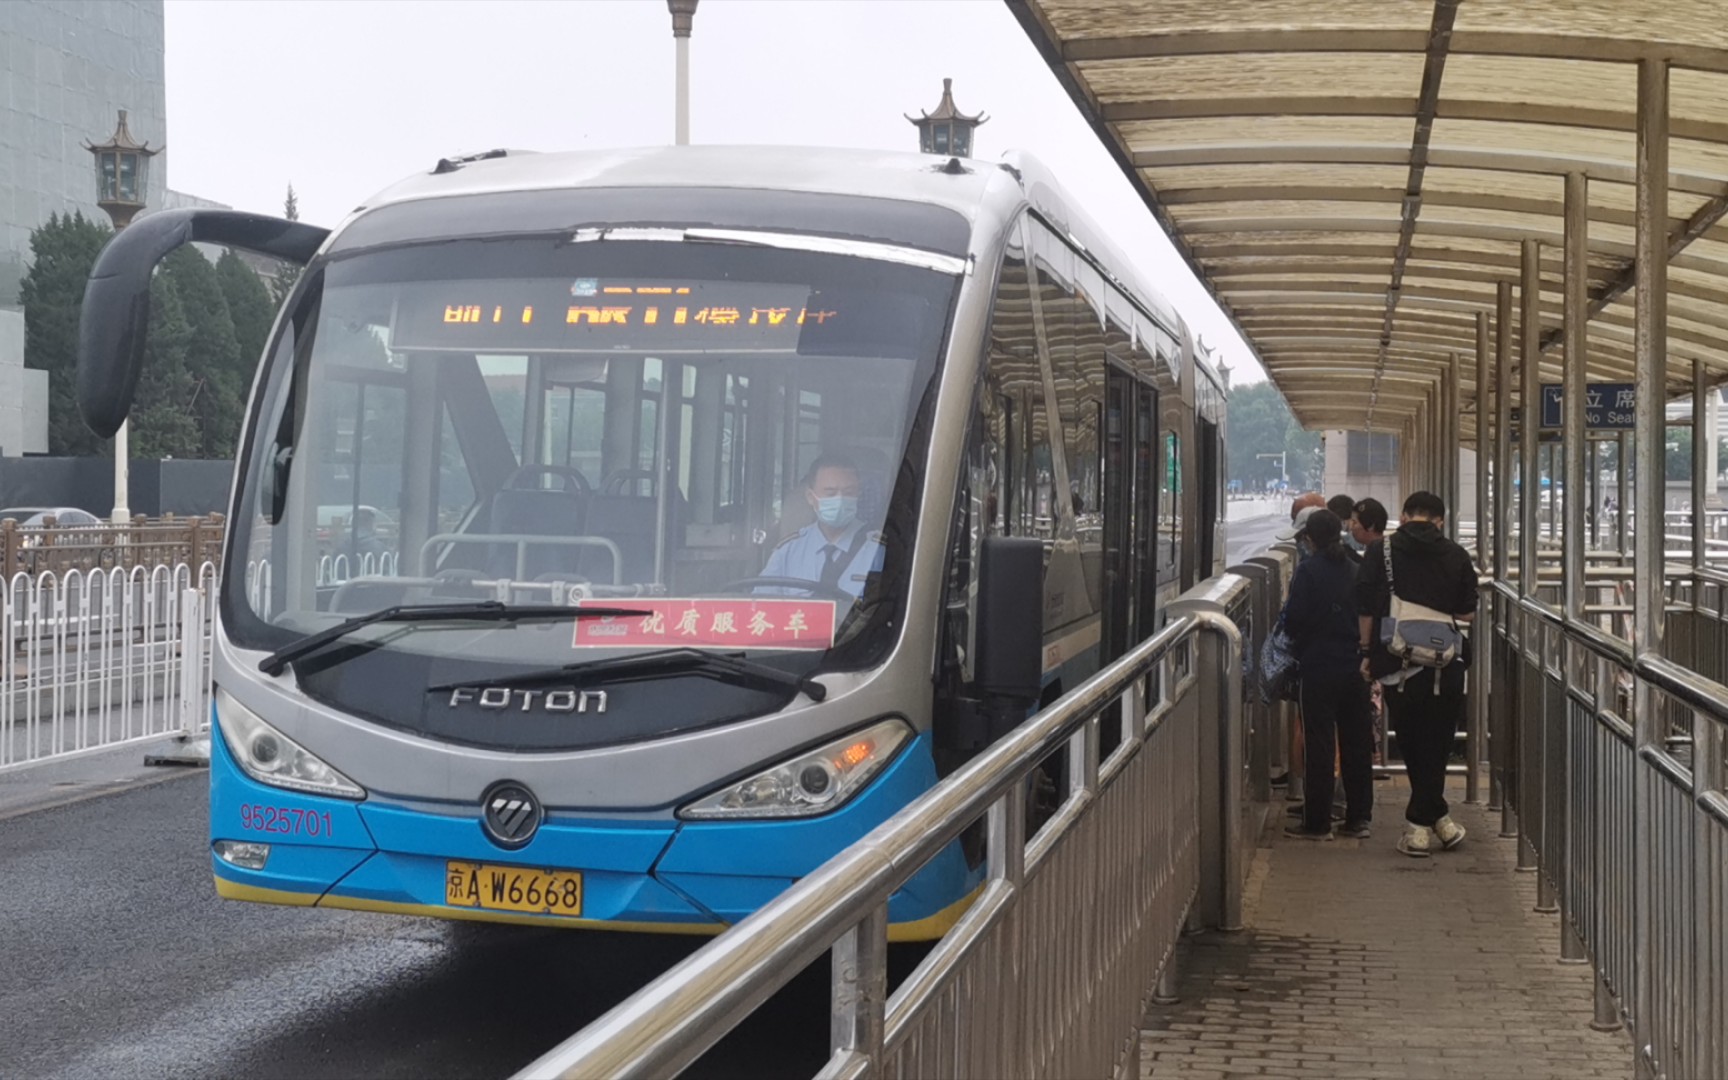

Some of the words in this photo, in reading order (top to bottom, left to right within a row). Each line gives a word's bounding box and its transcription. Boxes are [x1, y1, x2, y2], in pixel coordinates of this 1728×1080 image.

[639, 604, 808, 639] 优质服务车
[449, 687, 608, 713] FOTON
[240, 803, 332, 838] 9525701
